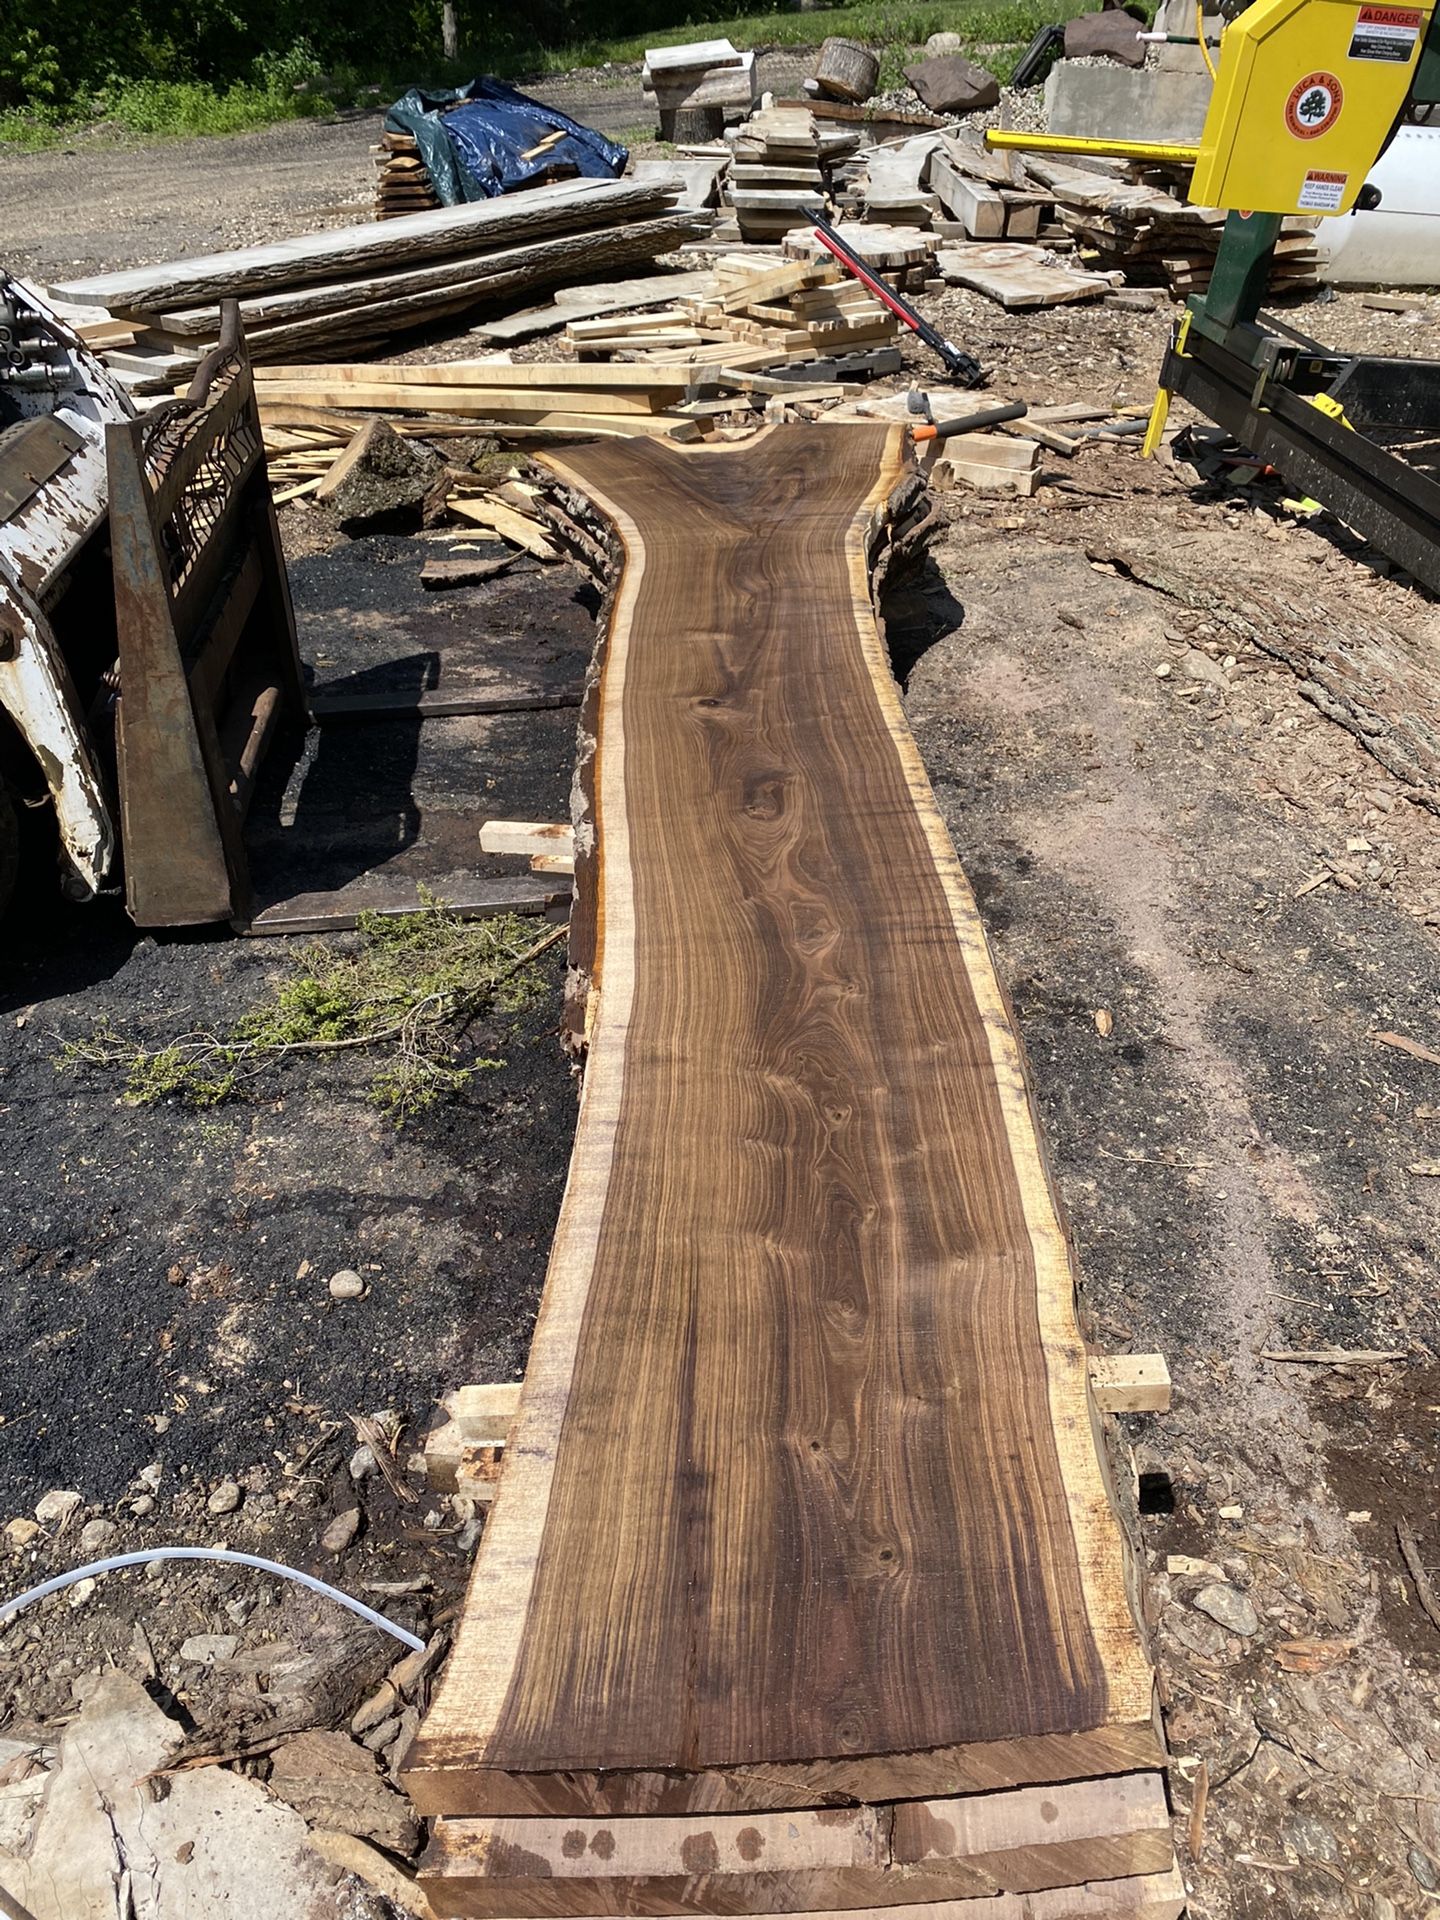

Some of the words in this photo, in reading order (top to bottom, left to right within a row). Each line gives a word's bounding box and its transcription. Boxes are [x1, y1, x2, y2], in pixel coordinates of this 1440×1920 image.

[1374, 10, 1420, 25] DANGER
[1292, 77, 1316, 99] LUCA
[1327, 79, 1340, 103] SONS
[1314, 172, 1345, 183] WARNING
